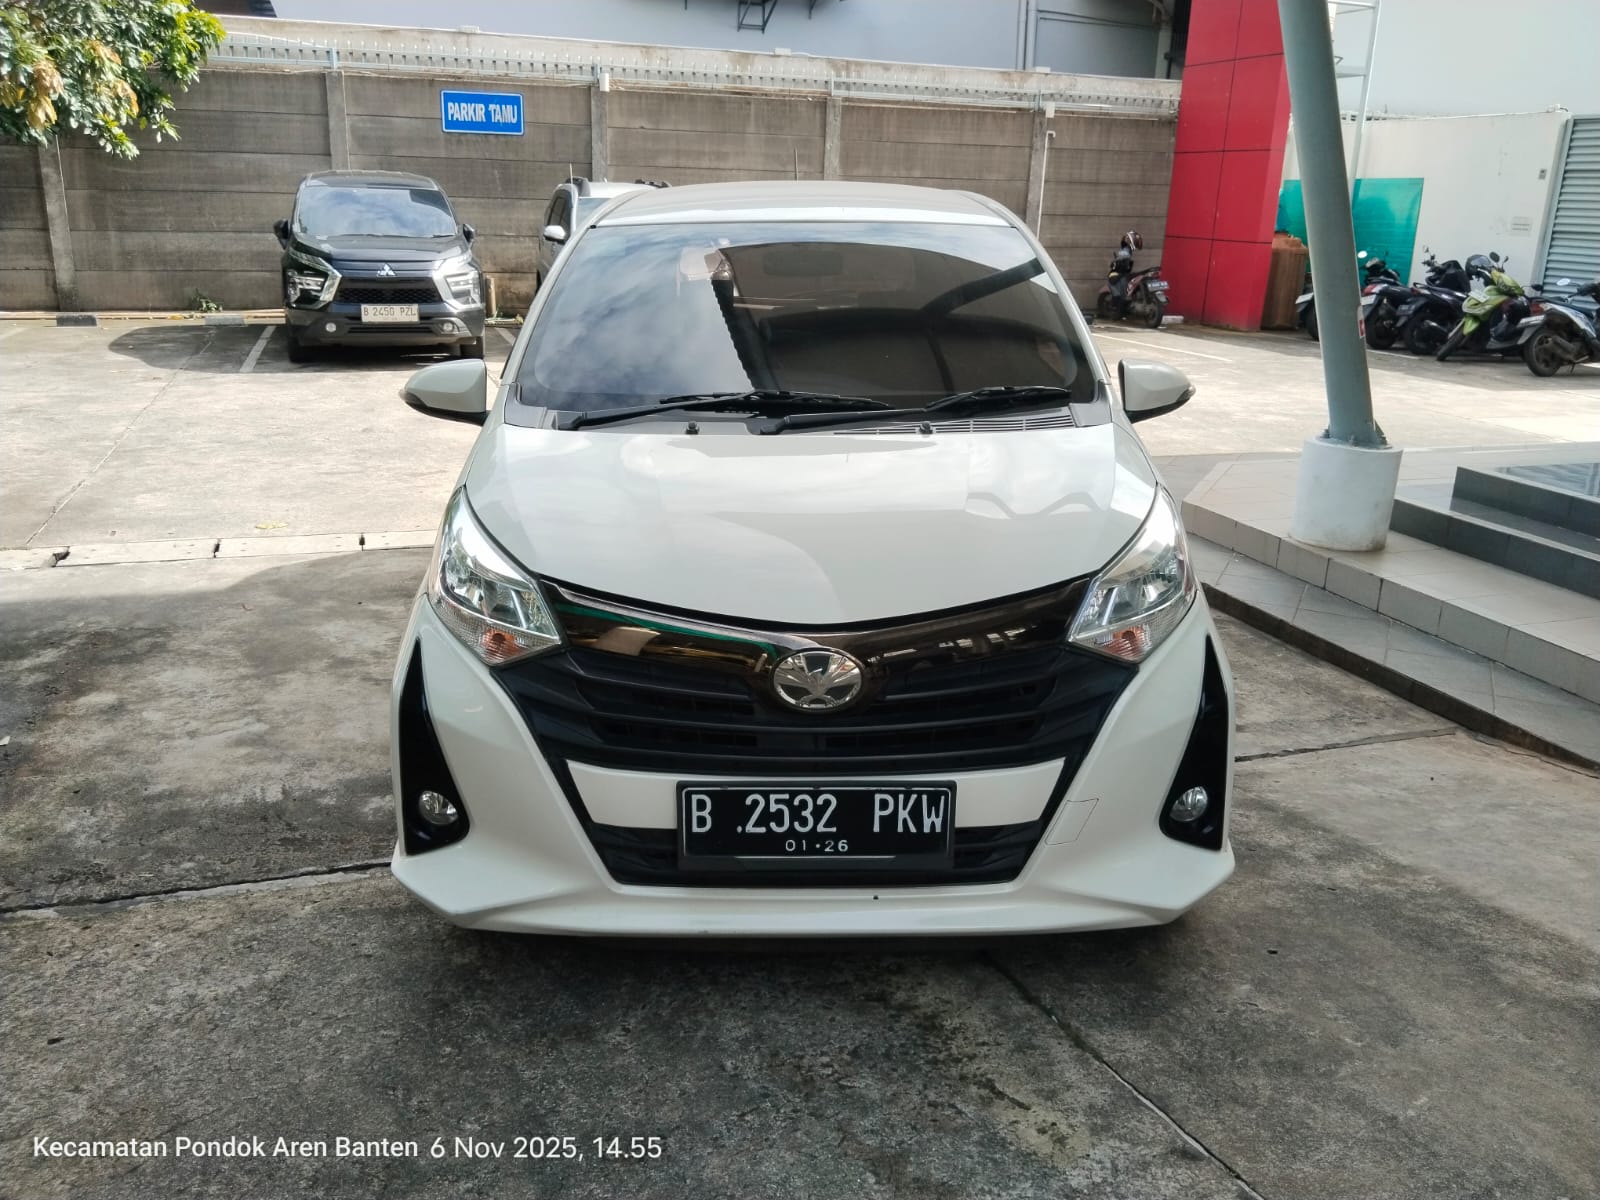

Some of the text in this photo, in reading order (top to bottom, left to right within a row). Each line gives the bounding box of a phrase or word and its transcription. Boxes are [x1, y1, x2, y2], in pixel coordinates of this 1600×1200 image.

[447, 102, 518, 124] PARKIR TAMU
[364, 307, 369, 316] B
[691, 794, 712, 833] B
[873, 794, 945, 834] PKW
